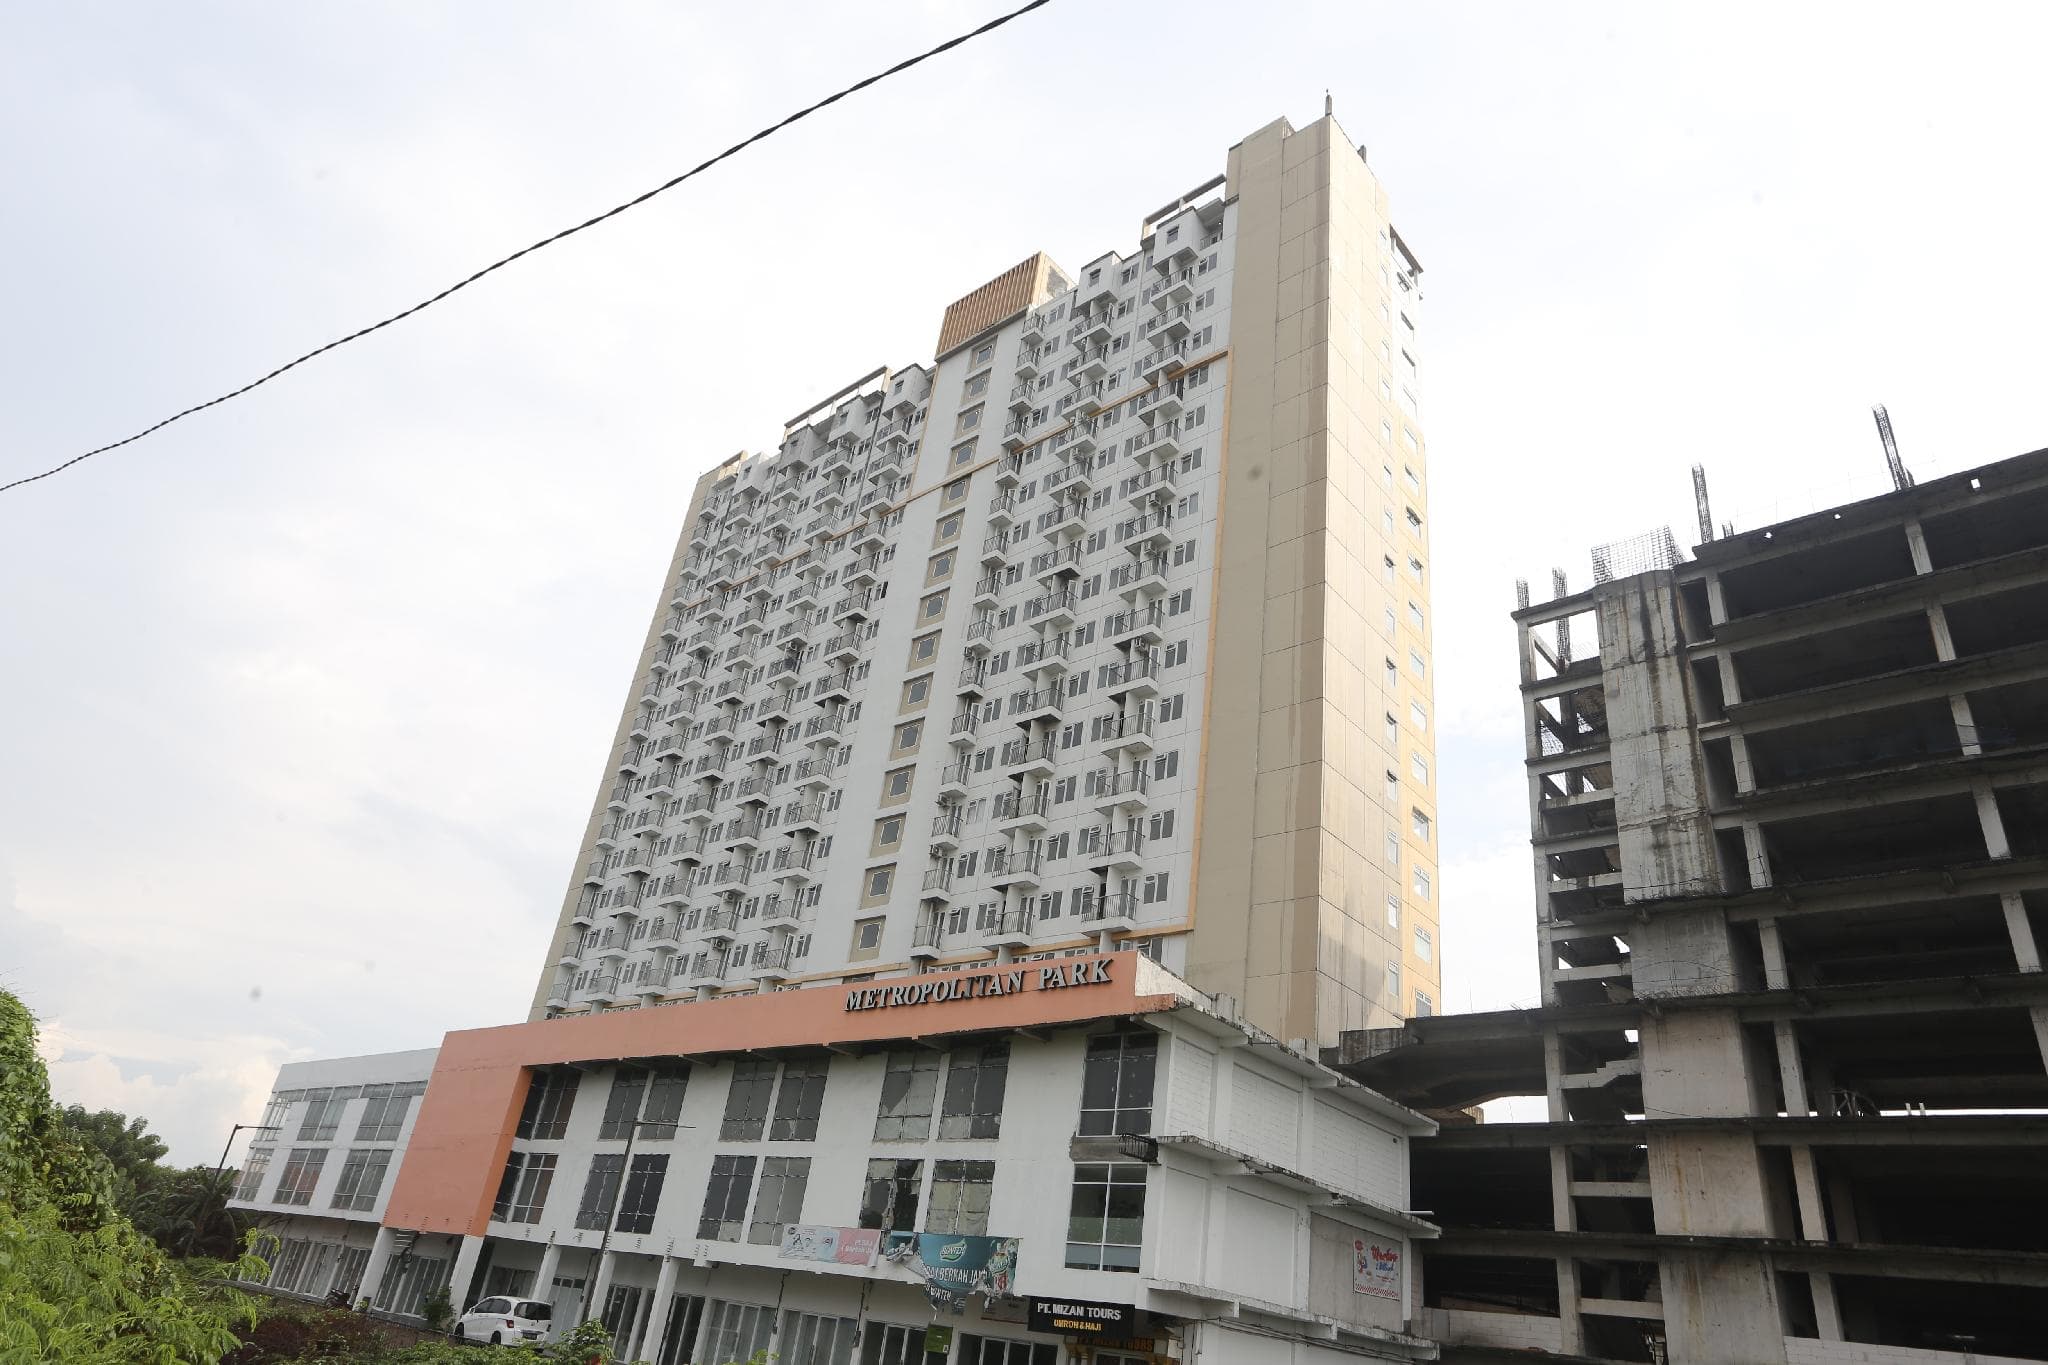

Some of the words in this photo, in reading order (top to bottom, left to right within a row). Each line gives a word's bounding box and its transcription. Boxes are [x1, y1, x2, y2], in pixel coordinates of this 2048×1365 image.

[845, 970, 1025, 1012] METROPOLITAN
[1038, 958, 1115, 991] PARK
[939, 1267, 968, 1283] BERKAH
[1052, 1303, 1084, 1316] MIZAN
[1086, 1307, 1121, 1320] TOURS
[1053, 1319, 1078, 1329] UMROH
